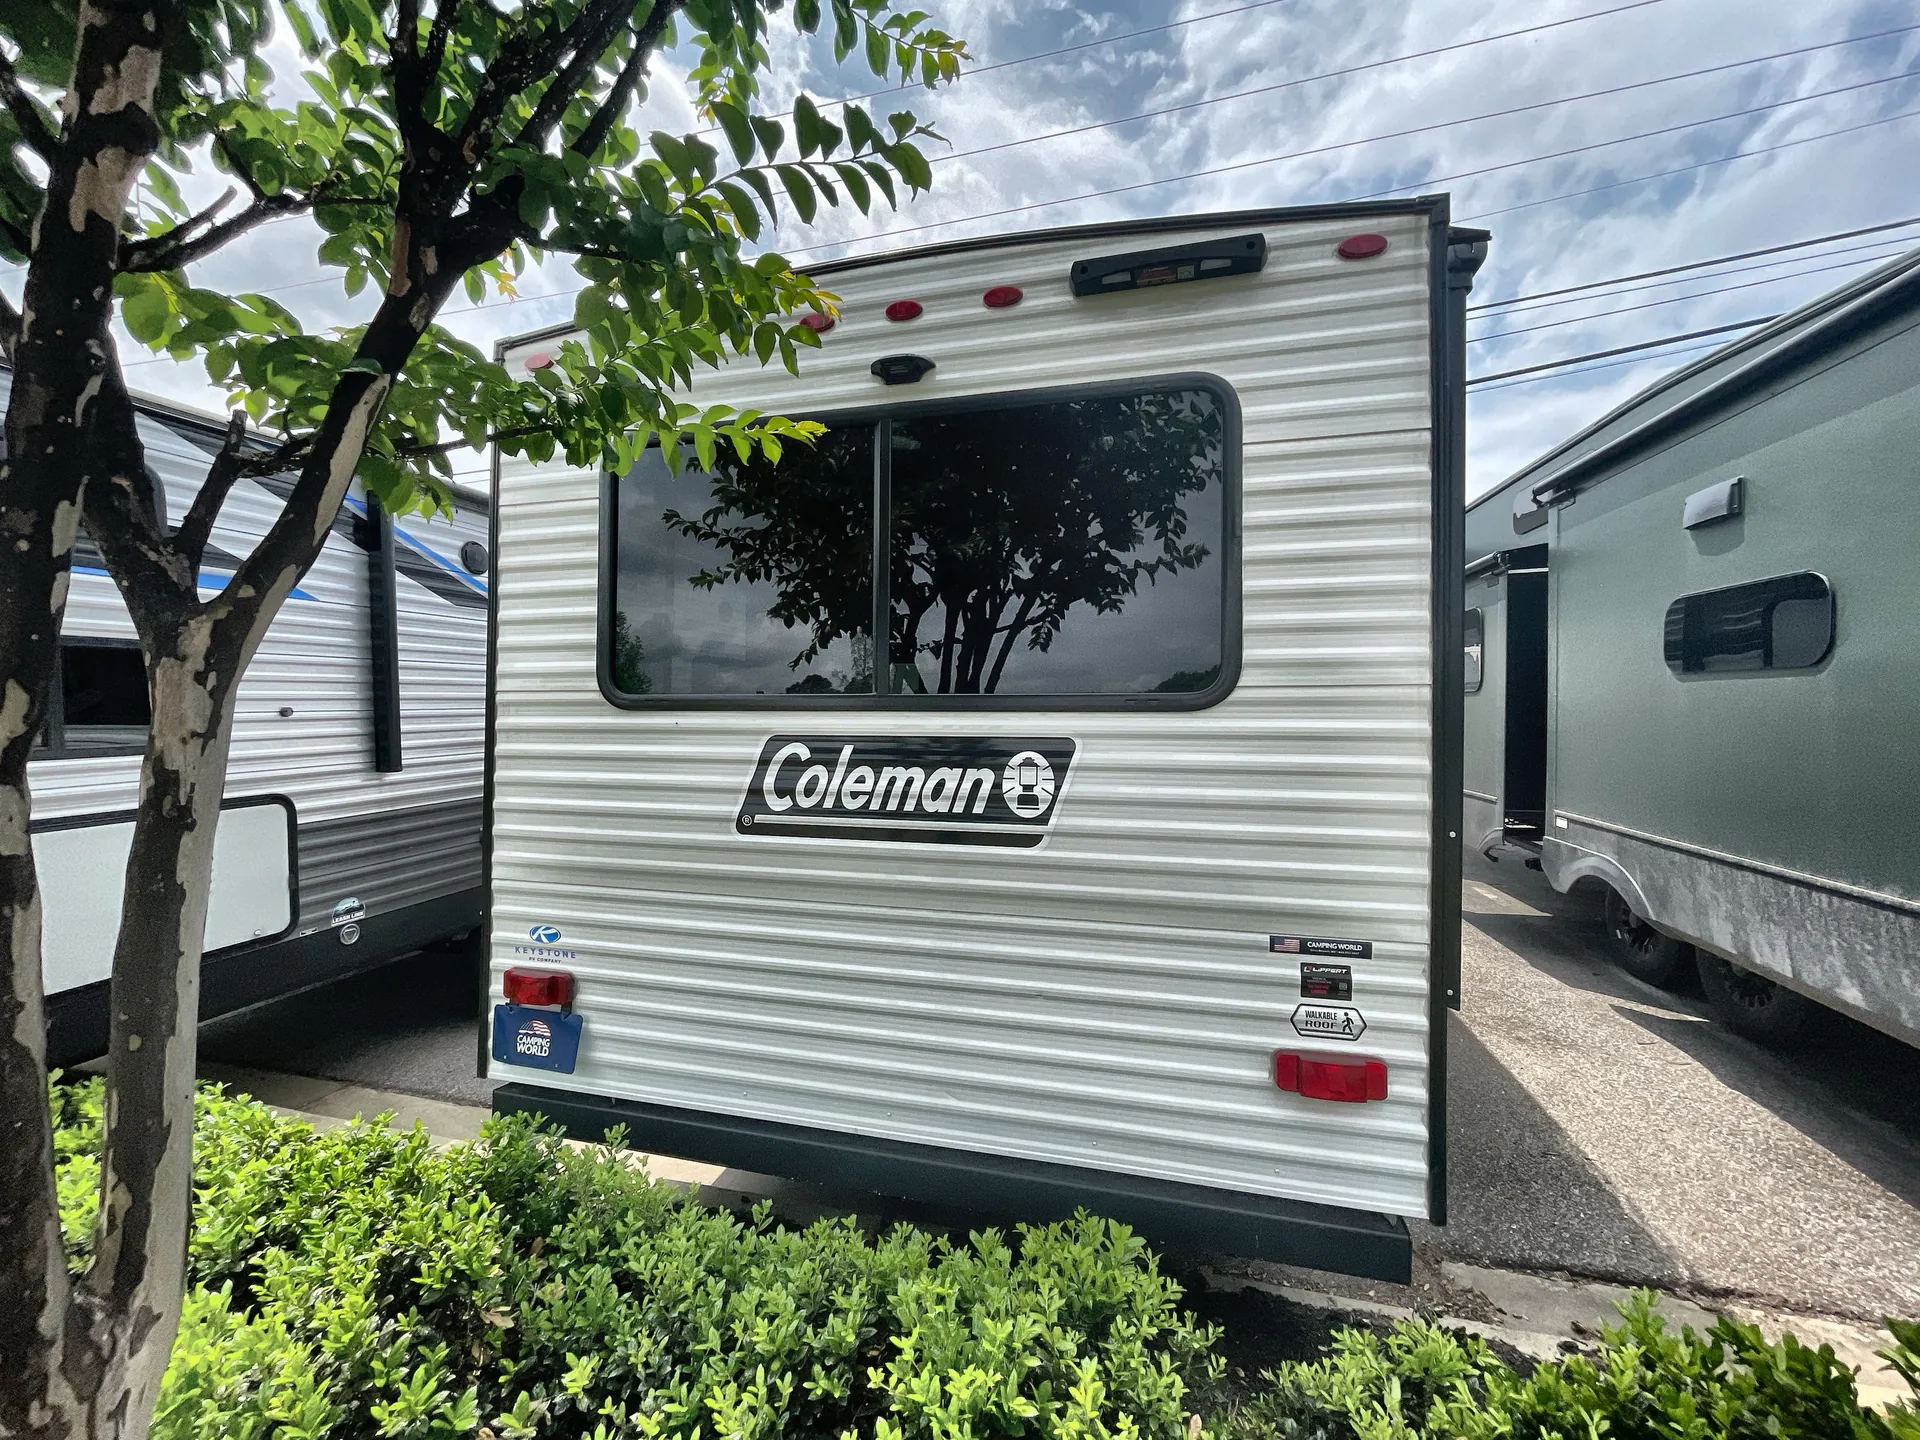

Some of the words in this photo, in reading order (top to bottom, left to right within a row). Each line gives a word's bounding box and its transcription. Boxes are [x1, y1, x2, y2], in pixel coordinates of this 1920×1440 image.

[762, 742, 996, 814] Coleman
[514, 946, 577, 959] KEYSTONE
[1307, 941, 1337, 950] CAMPING
[1337, 943, 1363, 951] WORLD
[1304, 1009, 1338, 1021] WALKABLE
[1304, 1020, 1337, 1030] ROOF
[516, 1034, 551, 1047] CAMPING
[516, 1043, 550, 1057] WORLD
